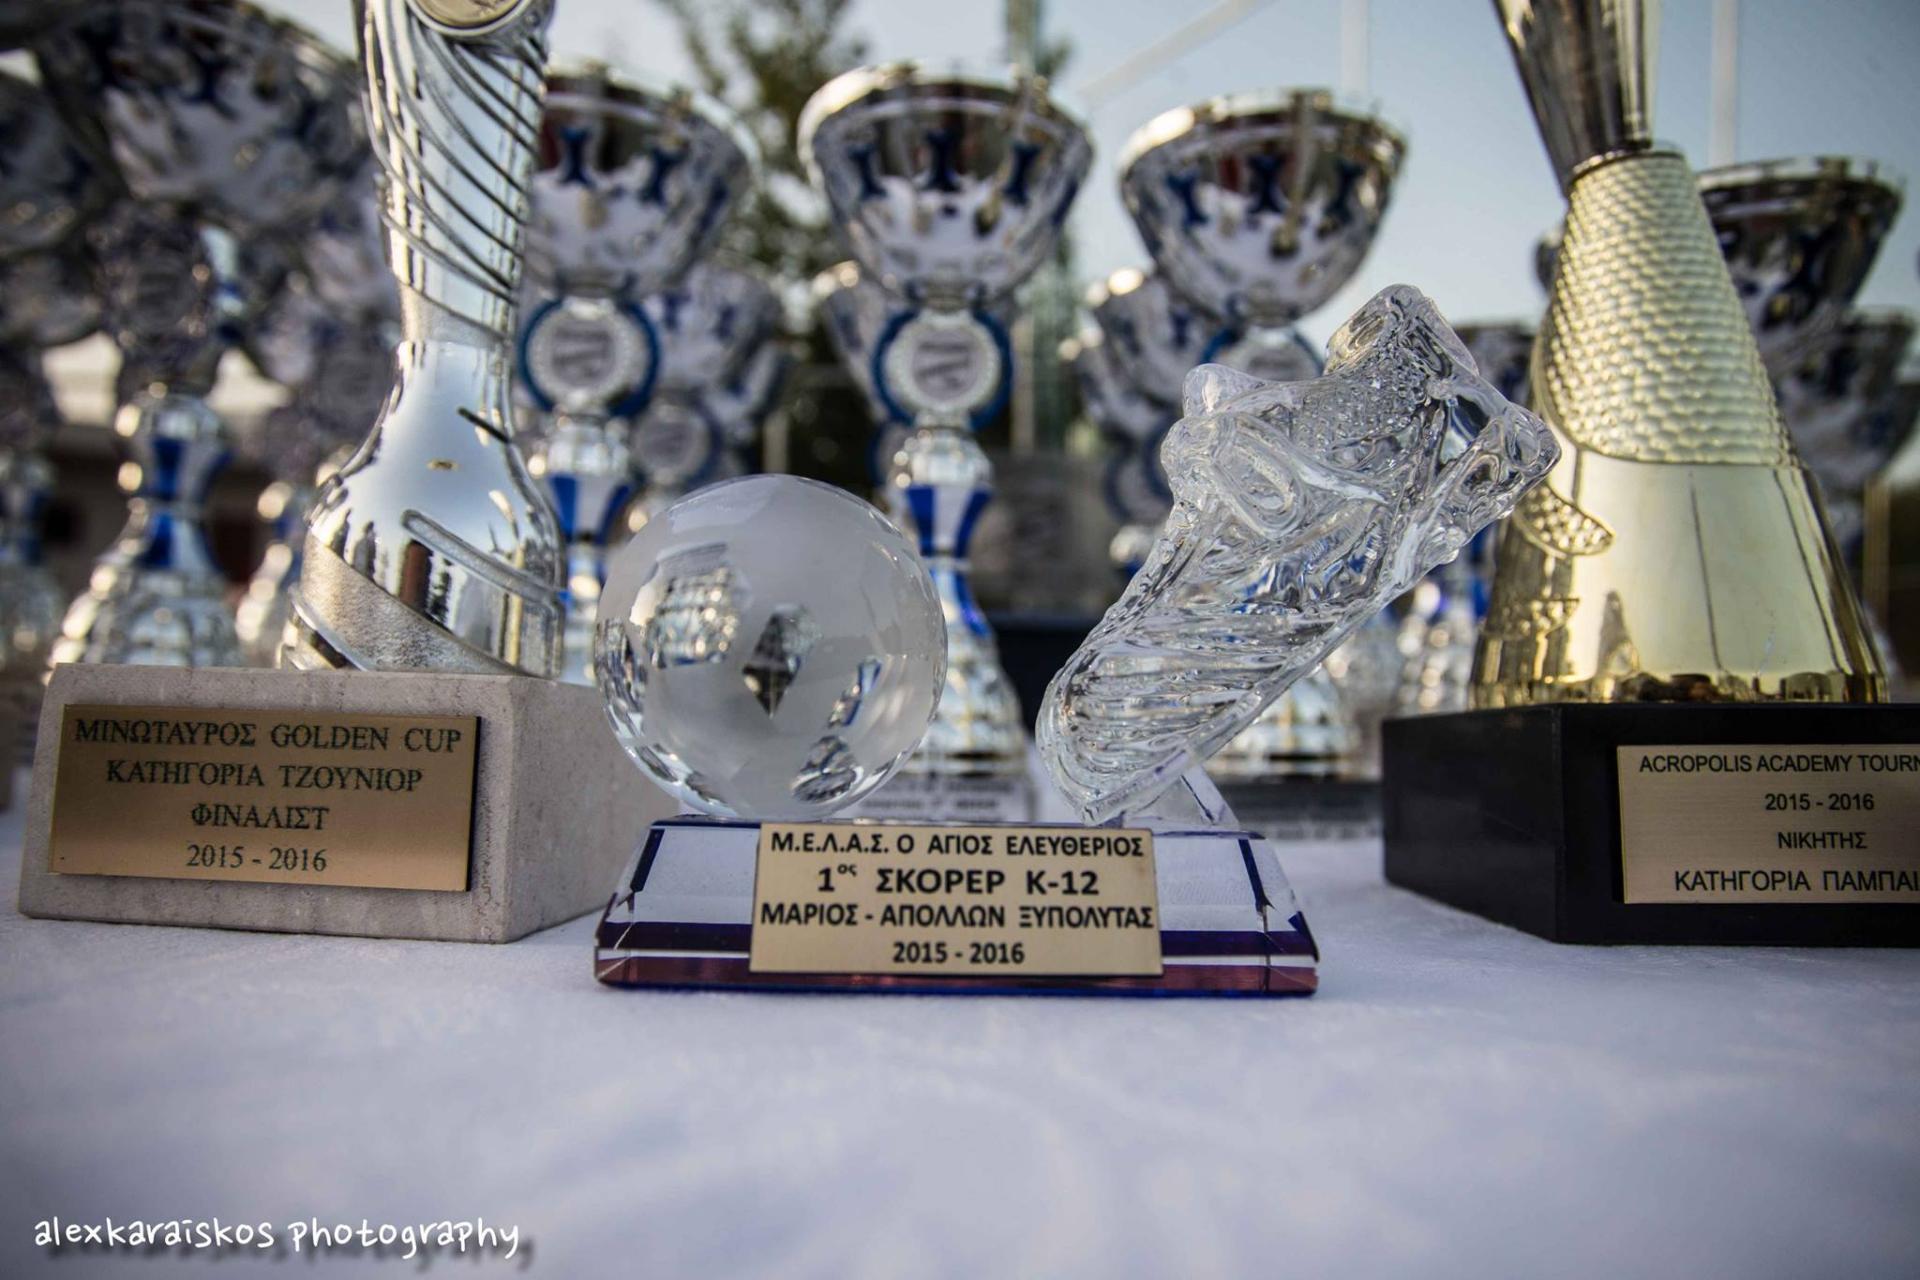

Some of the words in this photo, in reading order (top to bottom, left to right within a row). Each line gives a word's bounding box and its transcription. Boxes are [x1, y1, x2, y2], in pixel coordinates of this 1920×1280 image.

[75, 719, 257, 748] ΜΙΝΩΤΑΥΡΟΣ
[270, 725, 390, 751] GOLDEN
[404, 728, 462, 753] CUP
[106, 760, 265, 787] ΚΑΤΗΓΟΡΙΑ
[279, 765, 423, 792] ΤΖΟΥΝΙΟΡ
[1639, 754, 1753, 773] ACROPOLIS
[1756, 754, 1853, 773] ACADEMY
[1765, 793, 1811, 811] 2015
[1828, 793, 1875, 811] 2016
[190, 803, 330, 831] ΦΙΝΑΛΙΣΤ
[771, 832, 890, 854] Μ.Ε.Λ.Α.Σ.
[896, 834, 915, 855] Ο
[927, 835, 993, 856] ΑΓΙΟΣ
[1006, 836, 1144, 857] ΕΛΕΥΘΕΡΙΟΣ
[1777, 831, 1868, 850] ΝΙΚΗΤΗΣ
[186, 844, 243, 869] 2015
[268, 847, 328, 872] 2016
[876, 868, 1006, 894] ΣΚΟΡΕΡ
[1674, 870, 1811, 892] ΚΑΤΗΓΟΡΙΑ
[1823, 870, 1920, 892] ΠΑΜΠΑΙ
[760, 903, 858, 926] ΜΑΡΙΟΣ
[880, 904, 1005, 928] ΑΠΟΛΛΩΝ
[1018, 905, 1154, 929] ΞΥΠΟΛΥΤΑΣ
[892, 942, 948, 964] 2015
[969, 942, 1025, 964] 2016
